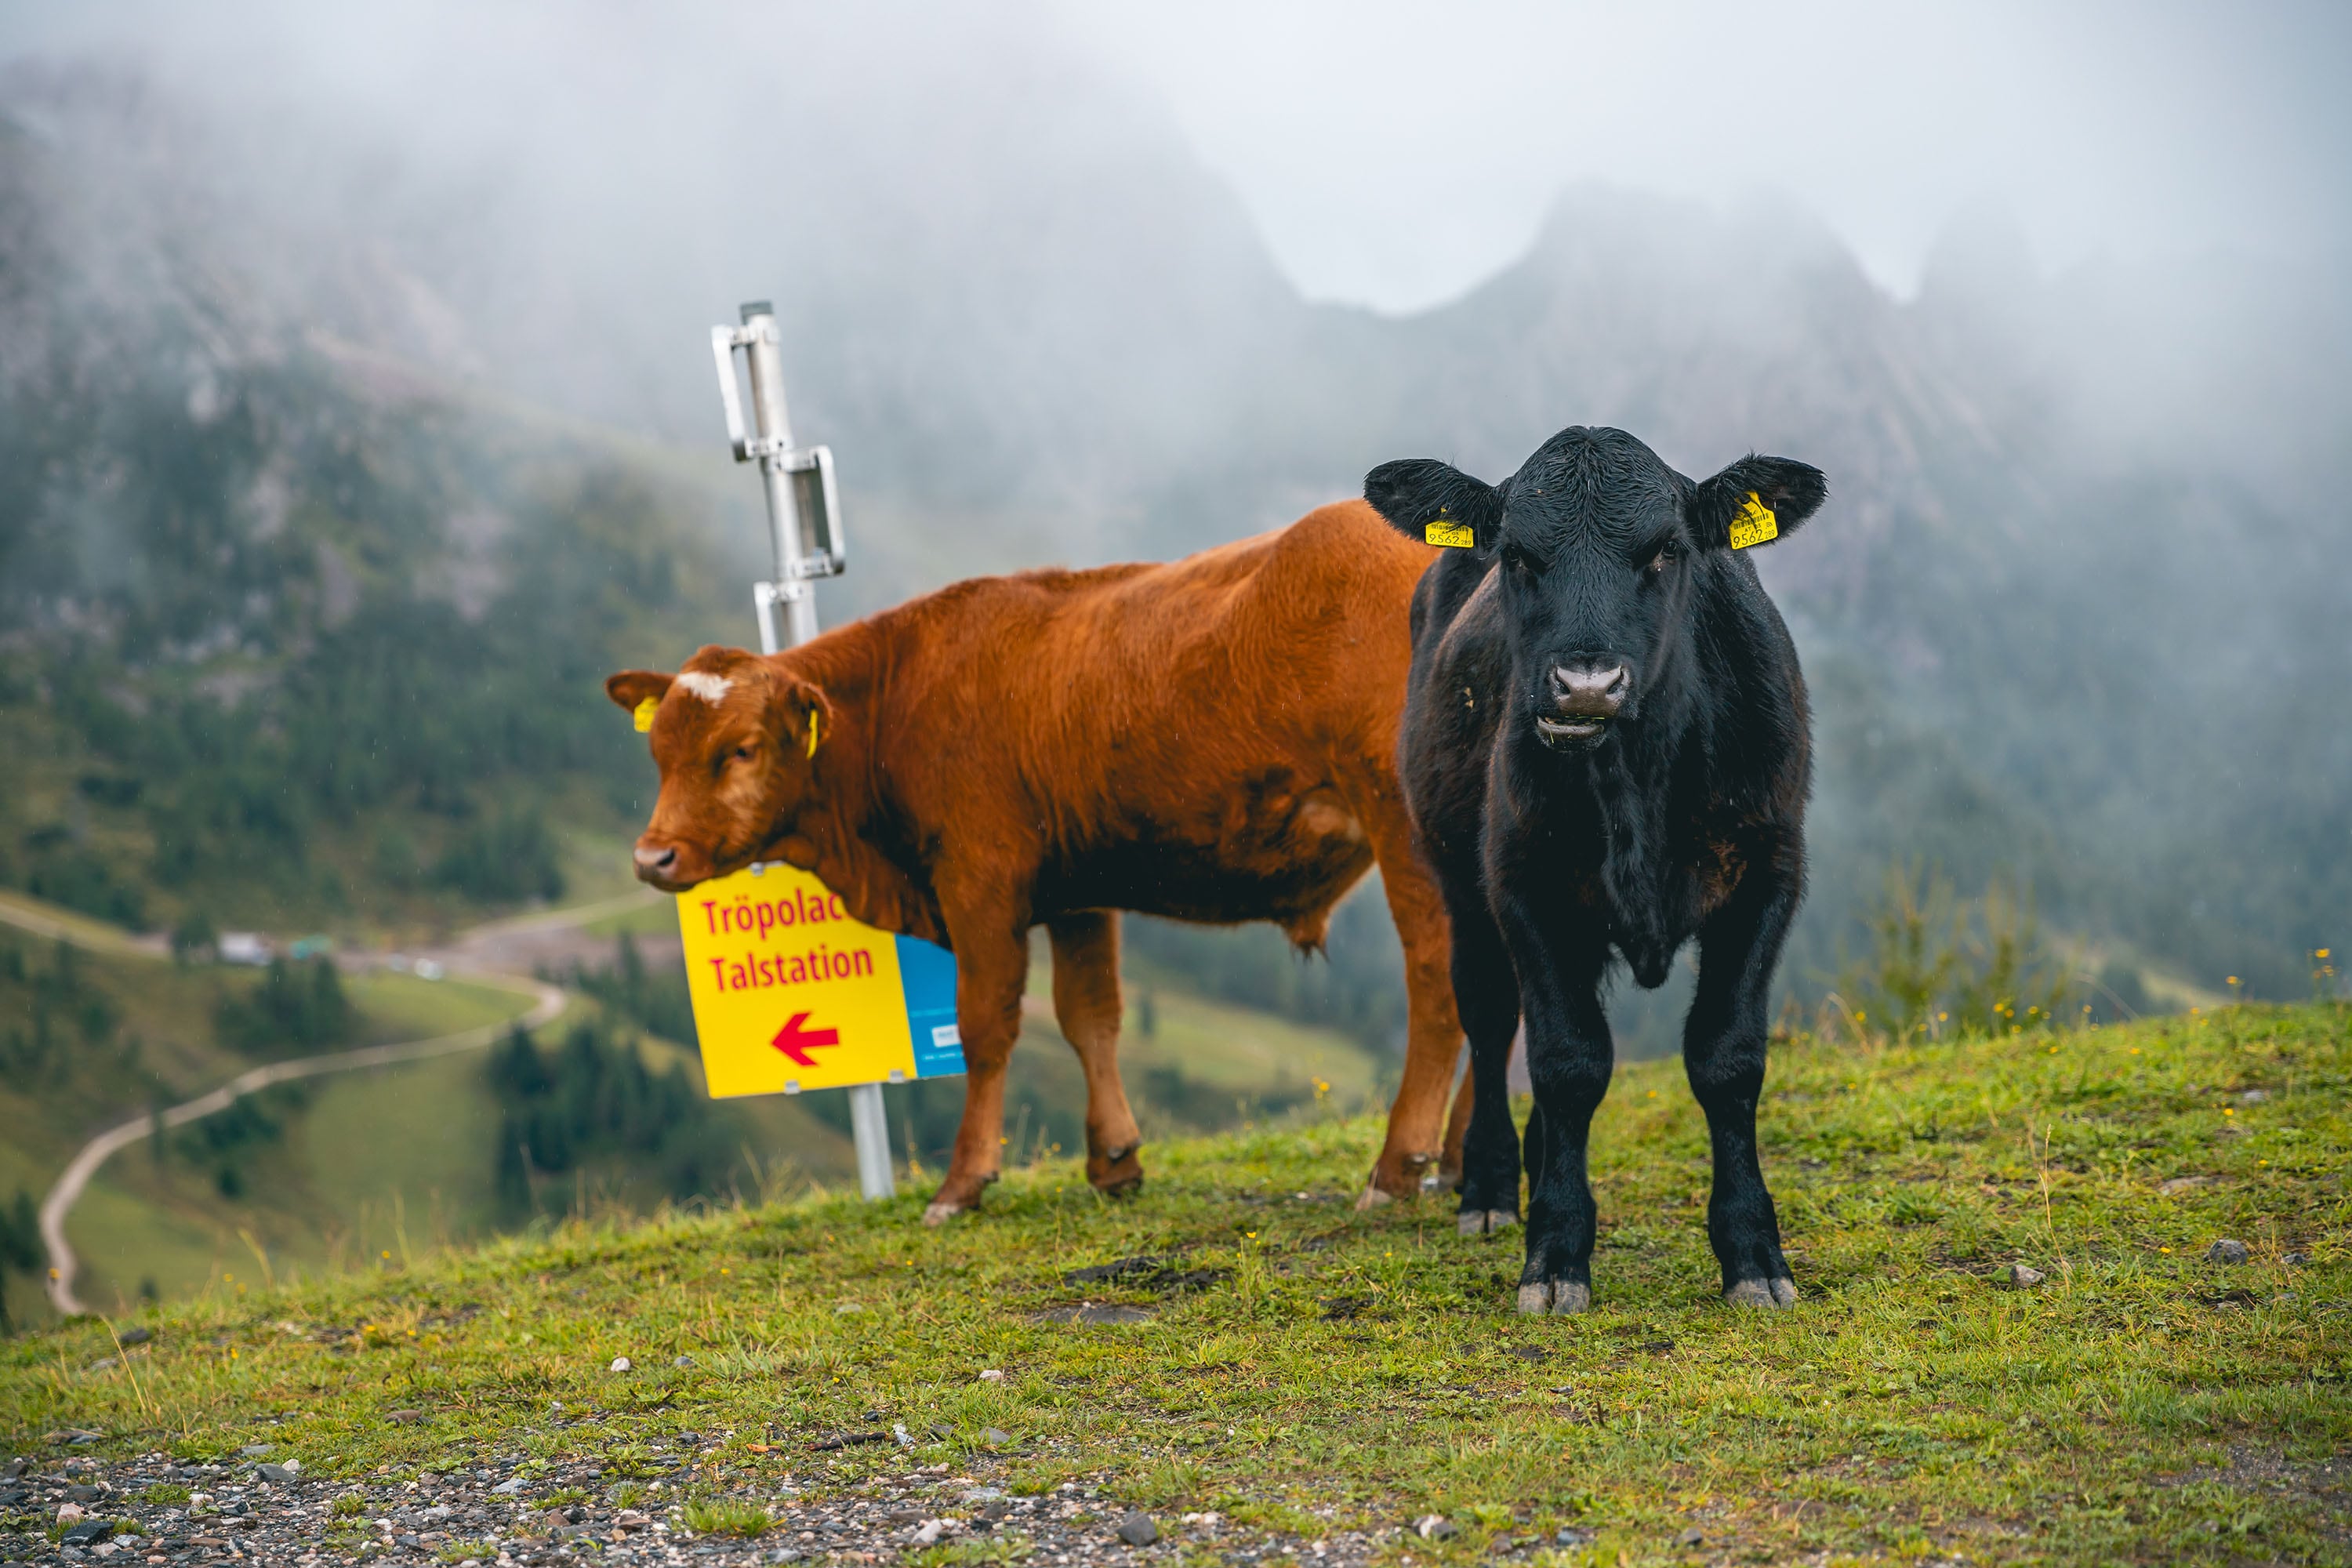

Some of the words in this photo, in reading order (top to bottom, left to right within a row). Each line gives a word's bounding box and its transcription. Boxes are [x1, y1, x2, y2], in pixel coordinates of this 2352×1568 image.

[1429, 533, 1459, 545] 9562
[1733, 529, 1764, 548] 9562
[702, 887, 851, 940] Tröpolac
[710, 944, 874, 993] Talstation
